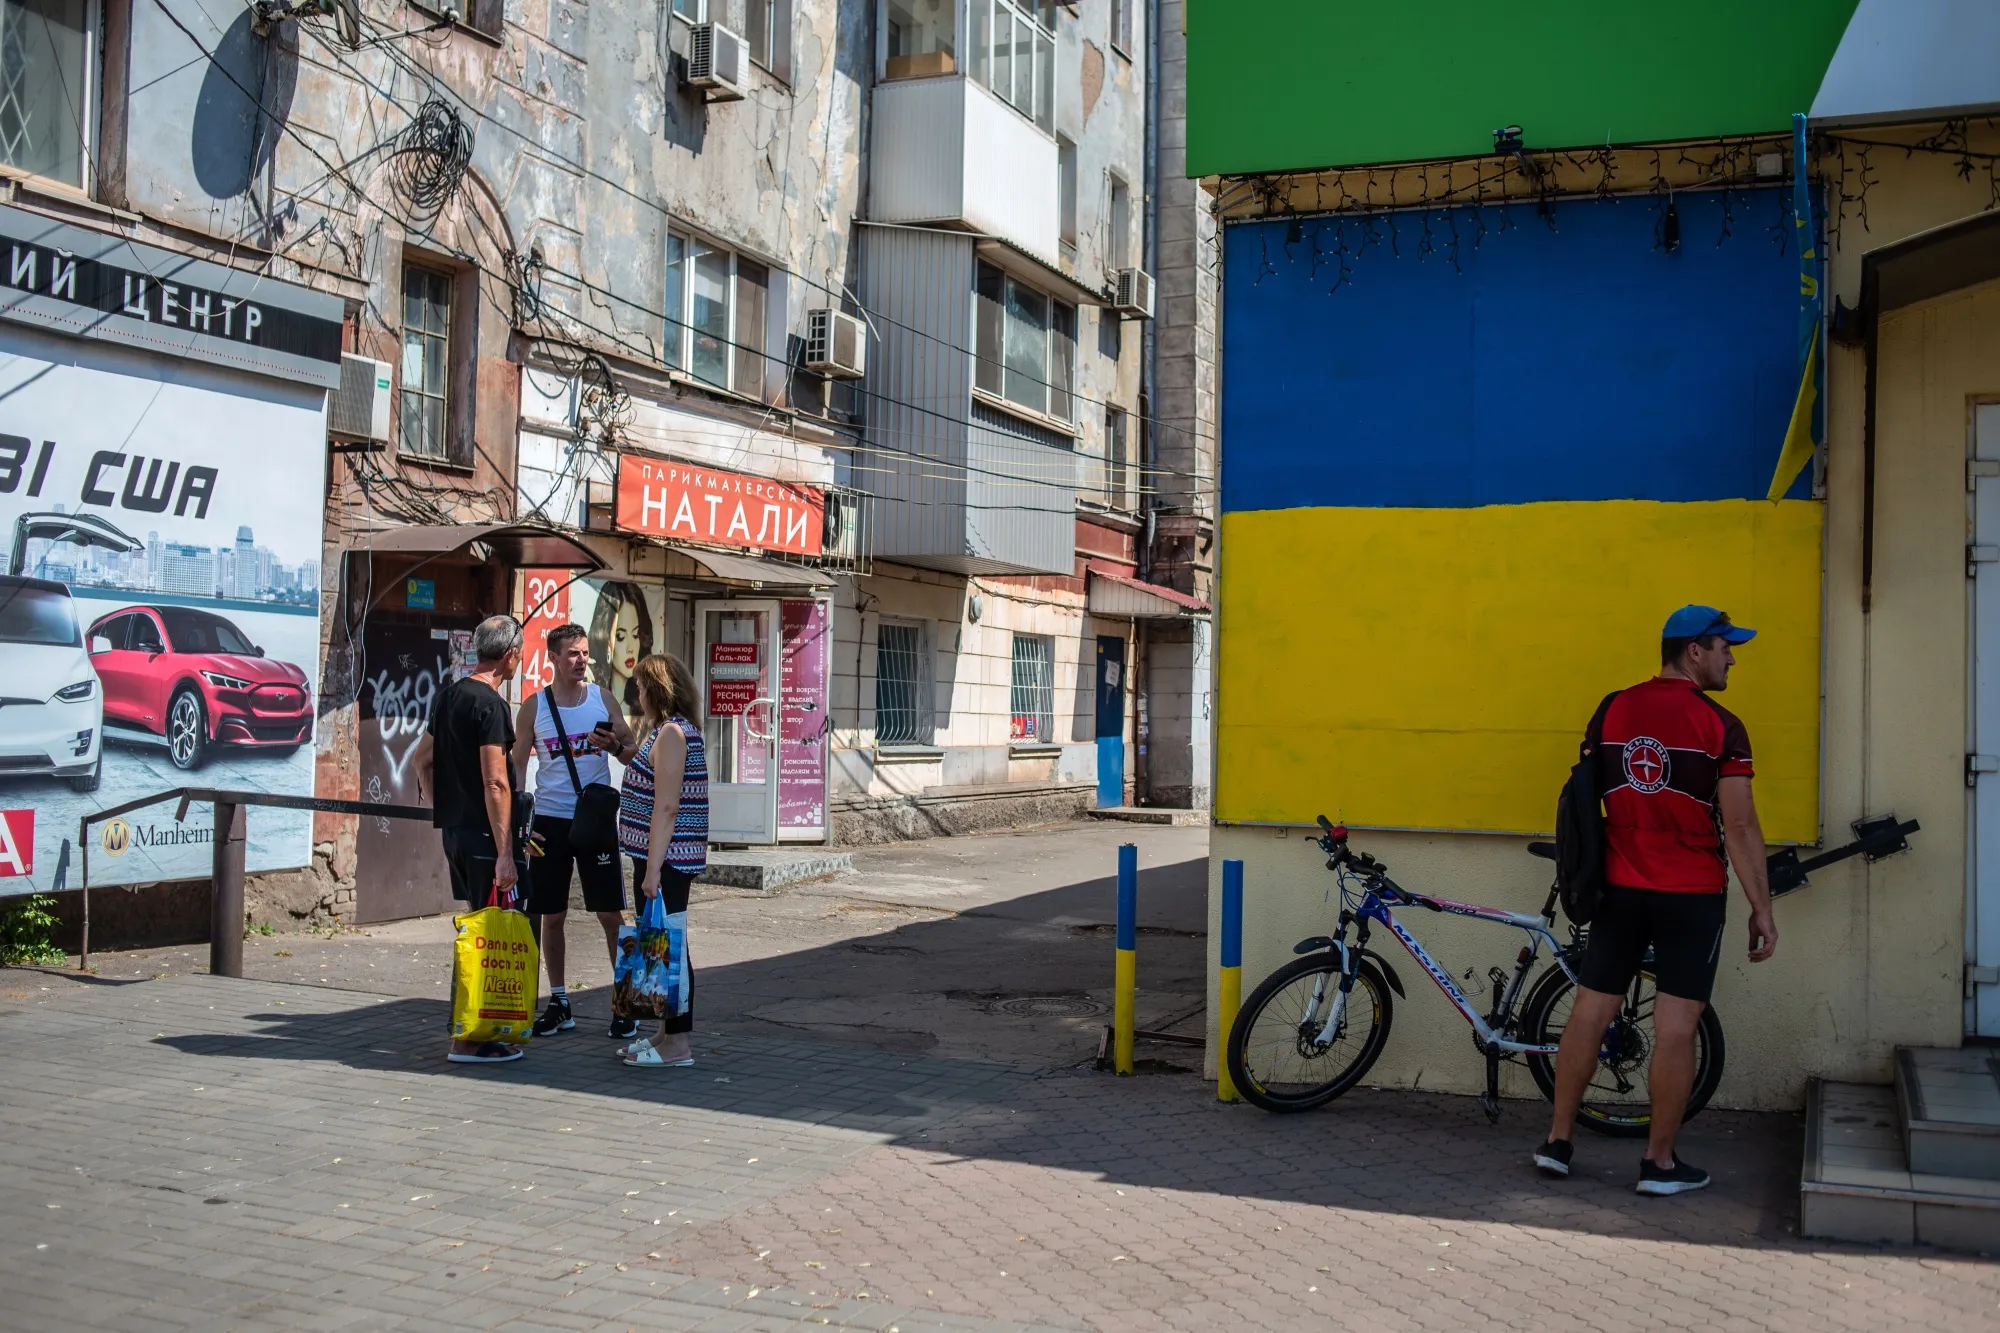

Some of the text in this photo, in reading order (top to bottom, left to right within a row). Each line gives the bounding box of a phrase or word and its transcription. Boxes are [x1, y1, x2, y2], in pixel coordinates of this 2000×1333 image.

[124, 274, 263, 341] ЦЕНТР
[80, 449, 219, 520] США
[642, 465, 808, 505] ПАРИКМАХЕРСКАЯ
[641, 485, 808, 548] НАТАЛИ
[527, 577, 558, 619] 30
[715, 645, 754, 654] Маникюр
[715, 653, 752, 661] Гель-лак
[524, 648, 555, 688] 45
[716, 691, 750, 700] РЕСНИЦ
[716, 703, 733, 712] 200
[1623, 738, 1668, 763] SCHWINN
[1627, 774, 1665, 791] QUALITY
[134, 821, 215, 847] Manheim
[484, 975, 523, 994] Netto
